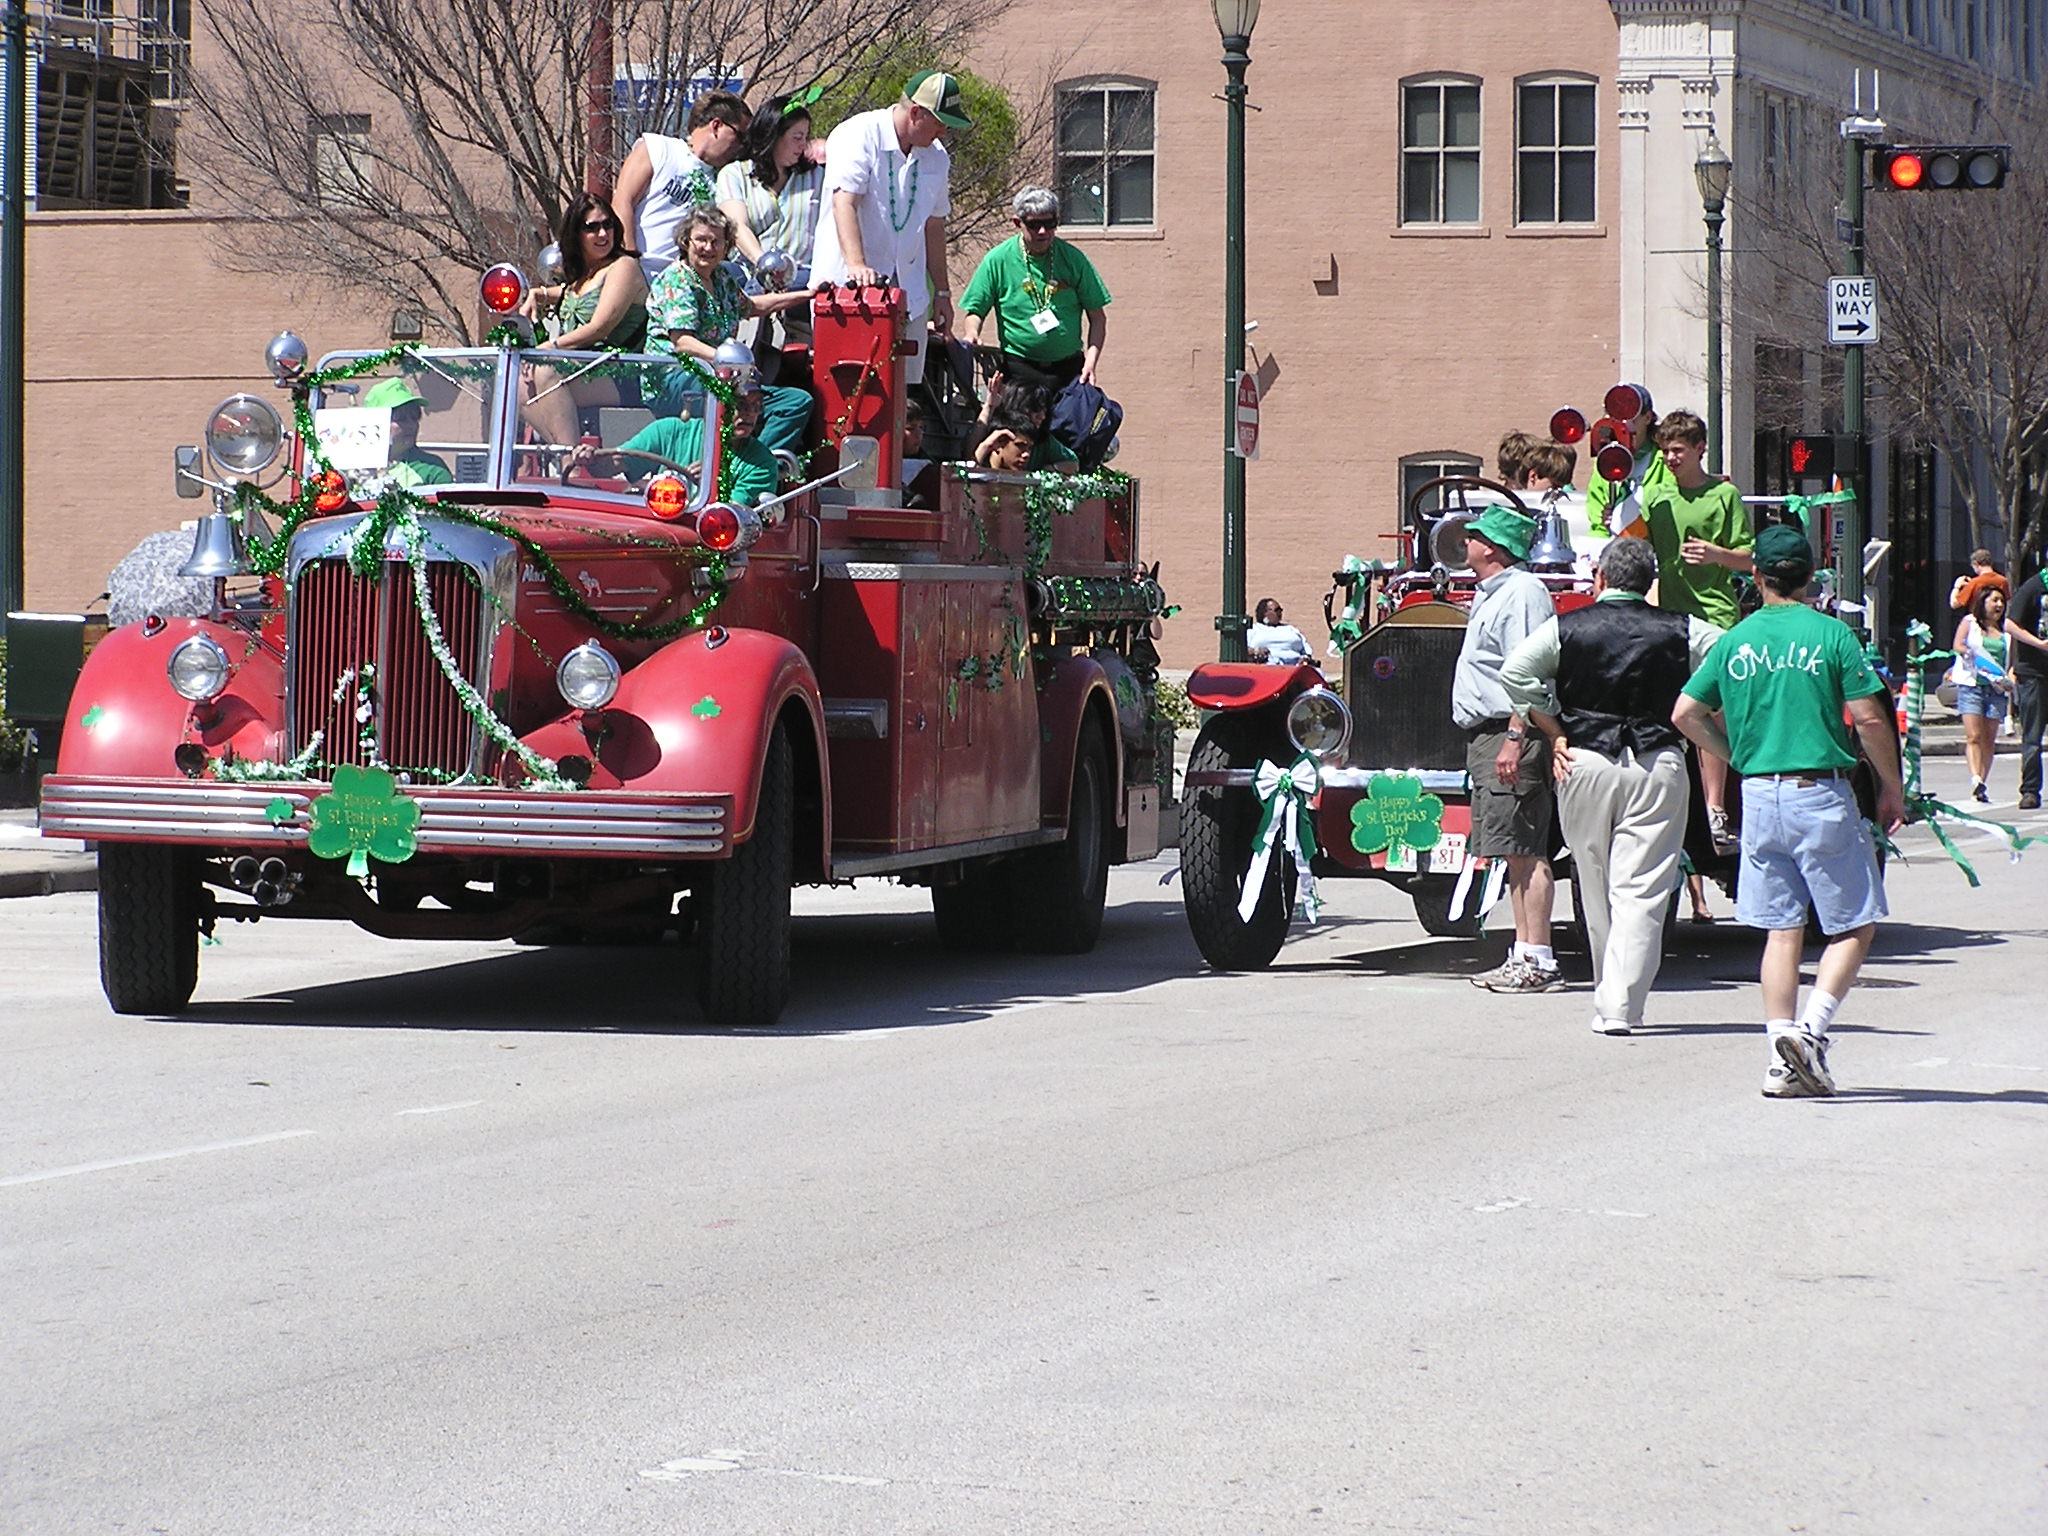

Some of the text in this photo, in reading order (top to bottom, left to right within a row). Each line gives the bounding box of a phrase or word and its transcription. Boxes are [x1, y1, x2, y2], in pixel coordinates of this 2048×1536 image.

[1836, 282, 1872, 298] ONE
[1835, 300, 1872, 316] WAY
[1380, 796, 1412, 810] Happy
